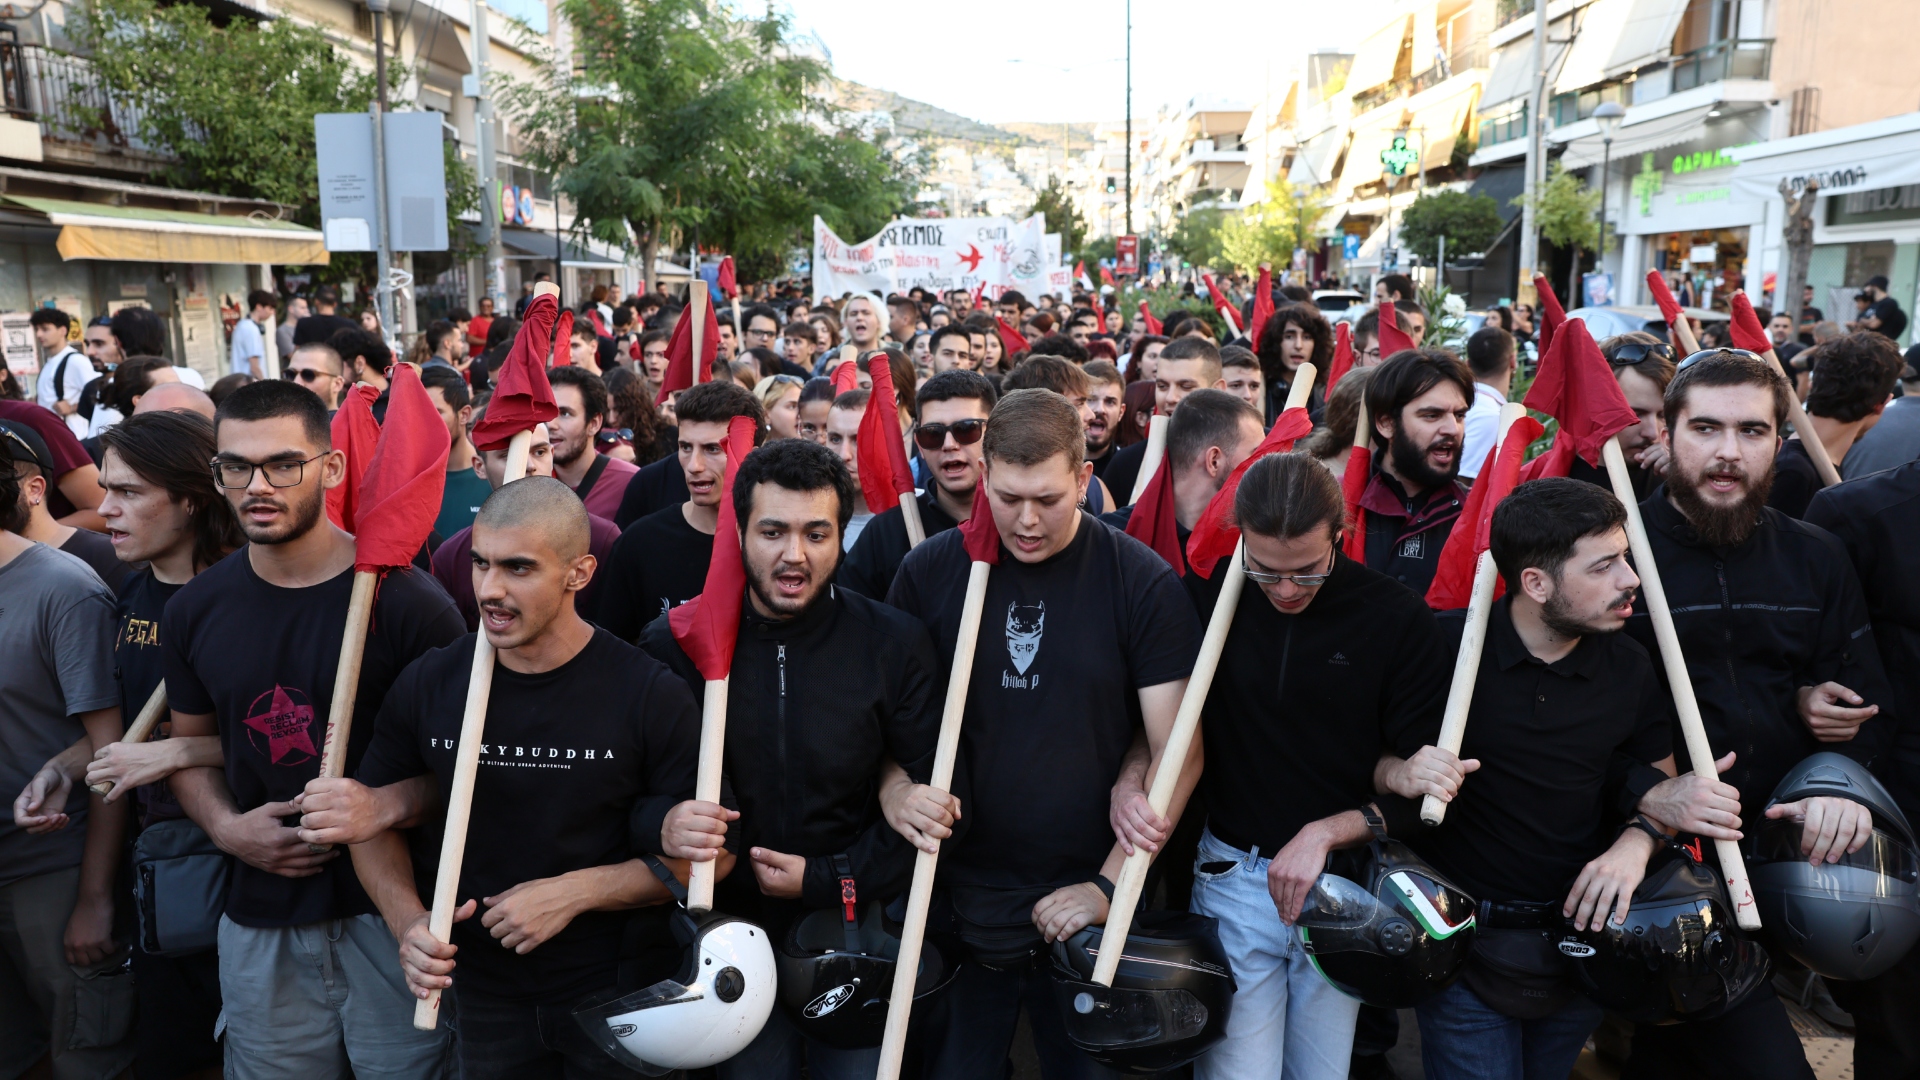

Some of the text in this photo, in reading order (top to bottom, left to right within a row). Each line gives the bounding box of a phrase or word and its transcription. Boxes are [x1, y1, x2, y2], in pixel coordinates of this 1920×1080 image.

[1404, 546, 1420, 557] DRY
[263, 711, 296, 725] RESIST
[271, 725, 304, 740] REVOLT
